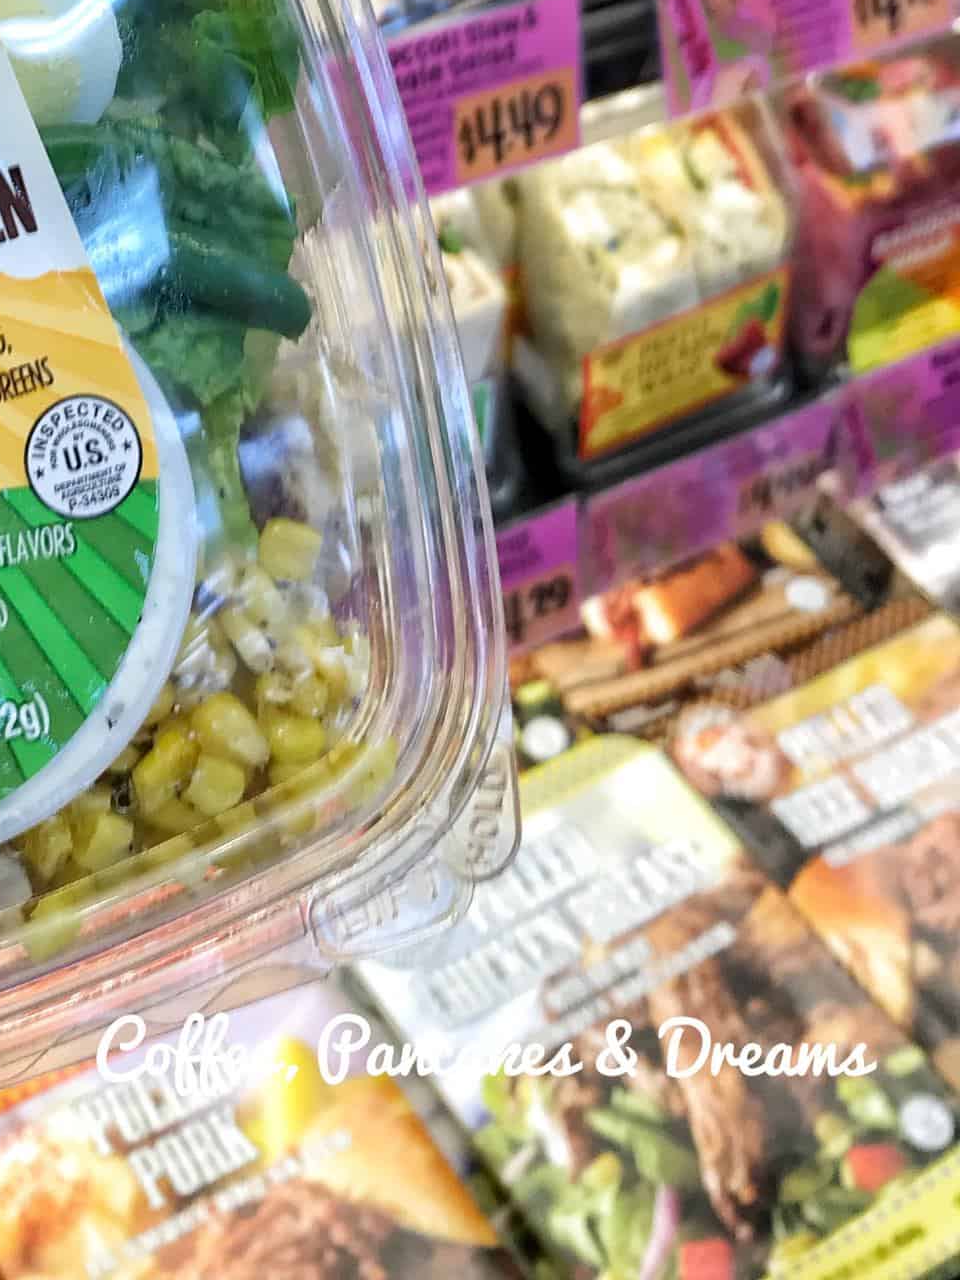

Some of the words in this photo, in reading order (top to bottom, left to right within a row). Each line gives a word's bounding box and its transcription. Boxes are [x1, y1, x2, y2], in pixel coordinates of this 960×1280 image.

[459, 82, 565, 165] $4.49
[32, 400, 125, 460] INSPECTED
[62, 438, 109, 472] U.S.
[127, 1103, 261, 1211] PORK
